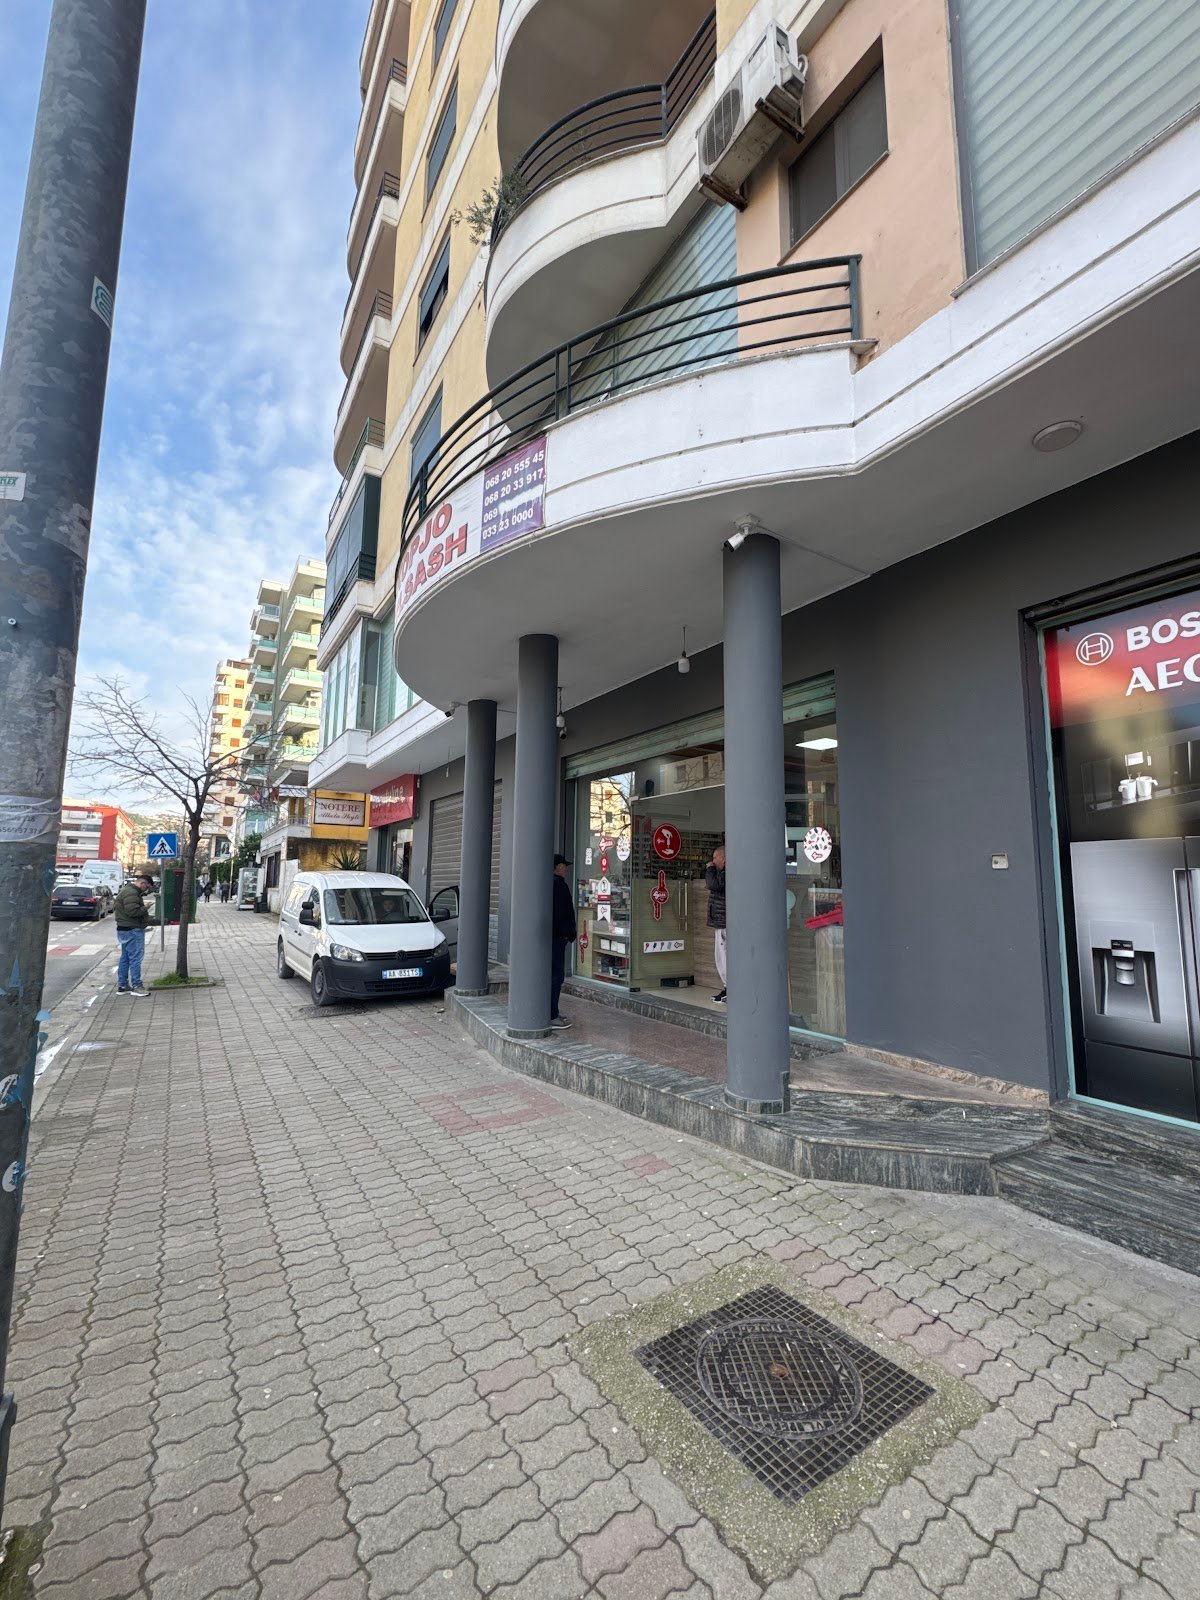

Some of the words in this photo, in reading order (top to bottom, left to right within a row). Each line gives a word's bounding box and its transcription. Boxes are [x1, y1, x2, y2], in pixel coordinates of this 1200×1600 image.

[485, 475, 500, 490] 068
[501, 468, 512, 481] 20
[513, 457, 530, 473] 555
[532, 450, 545, 463] 45
[484, 491, 499, 506] 068
[500, 484, 511, 497] 20
[513, 477, 524, 490] 33
[482, 524, 497, 539] 033
[498, 518, 510, 531] 23
[511, 508, 534, 525] 0000
[483, 508, 498, 523] 069
[320, 803, 361, 813] NOTERE
